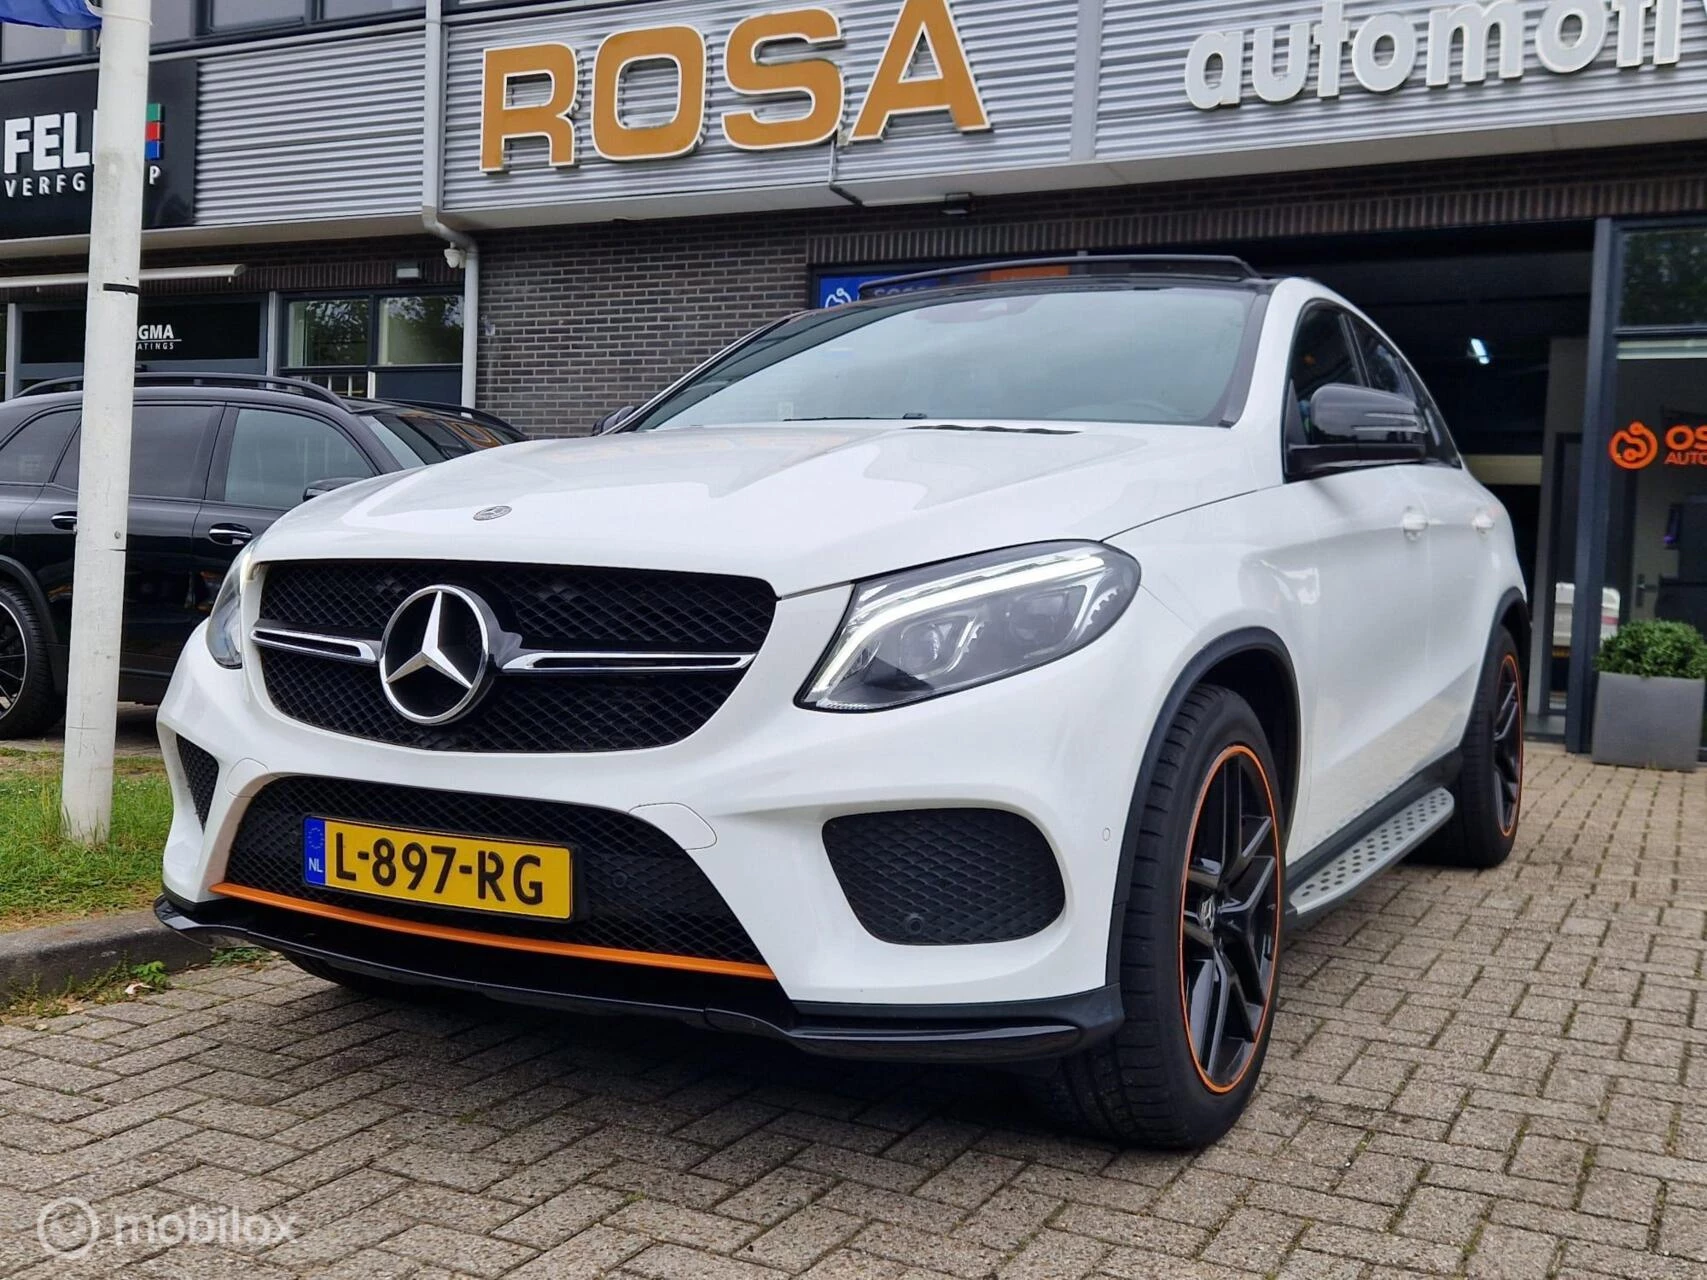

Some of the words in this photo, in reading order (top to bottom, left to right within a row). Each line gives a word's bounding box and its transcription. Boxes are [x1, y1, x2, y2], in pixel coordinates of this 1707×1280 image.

[1184, 0, 1707, 109] automoti
[479, 0, 993, 173] ROSA
[4, 109, 98, 174] FEL
[5, 165, 161, 197] VERFGP
[137, 342, 174, 350] ATINGS
[138, 324, 174, 340] GMA
[308, 858, 324, 873] NL
[335, 832, 544, 905] L-897-RG
